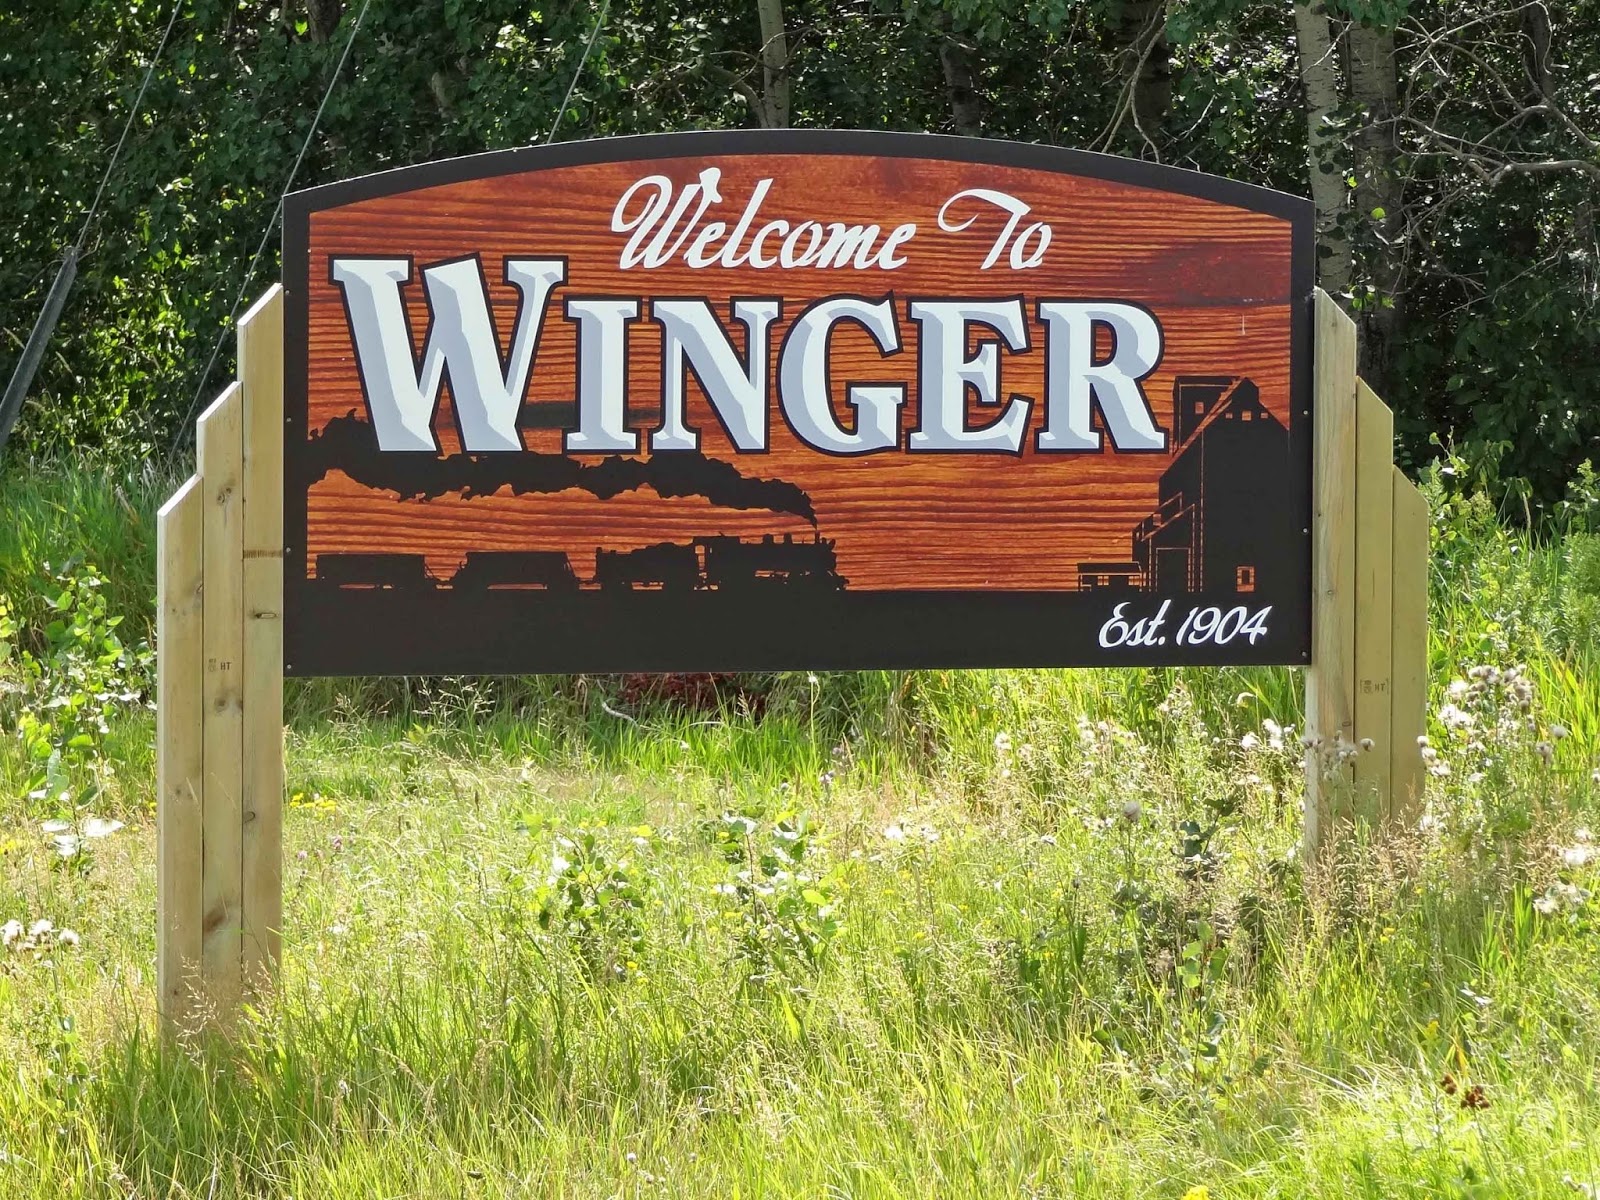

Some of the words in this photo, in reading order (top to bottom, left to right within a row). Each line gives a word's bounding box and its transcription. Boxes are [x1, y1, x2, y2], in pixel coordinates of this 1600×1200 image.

[611, 167, 917, 271] Welcome
[937, 188, 1053, 270] To
[328, 252, 1169, 457] WINGER
[1099, 599, 1171, 648] Est.
[1175, 605, 1273, 646] 1904
[220, 661, 232, 671] HT
